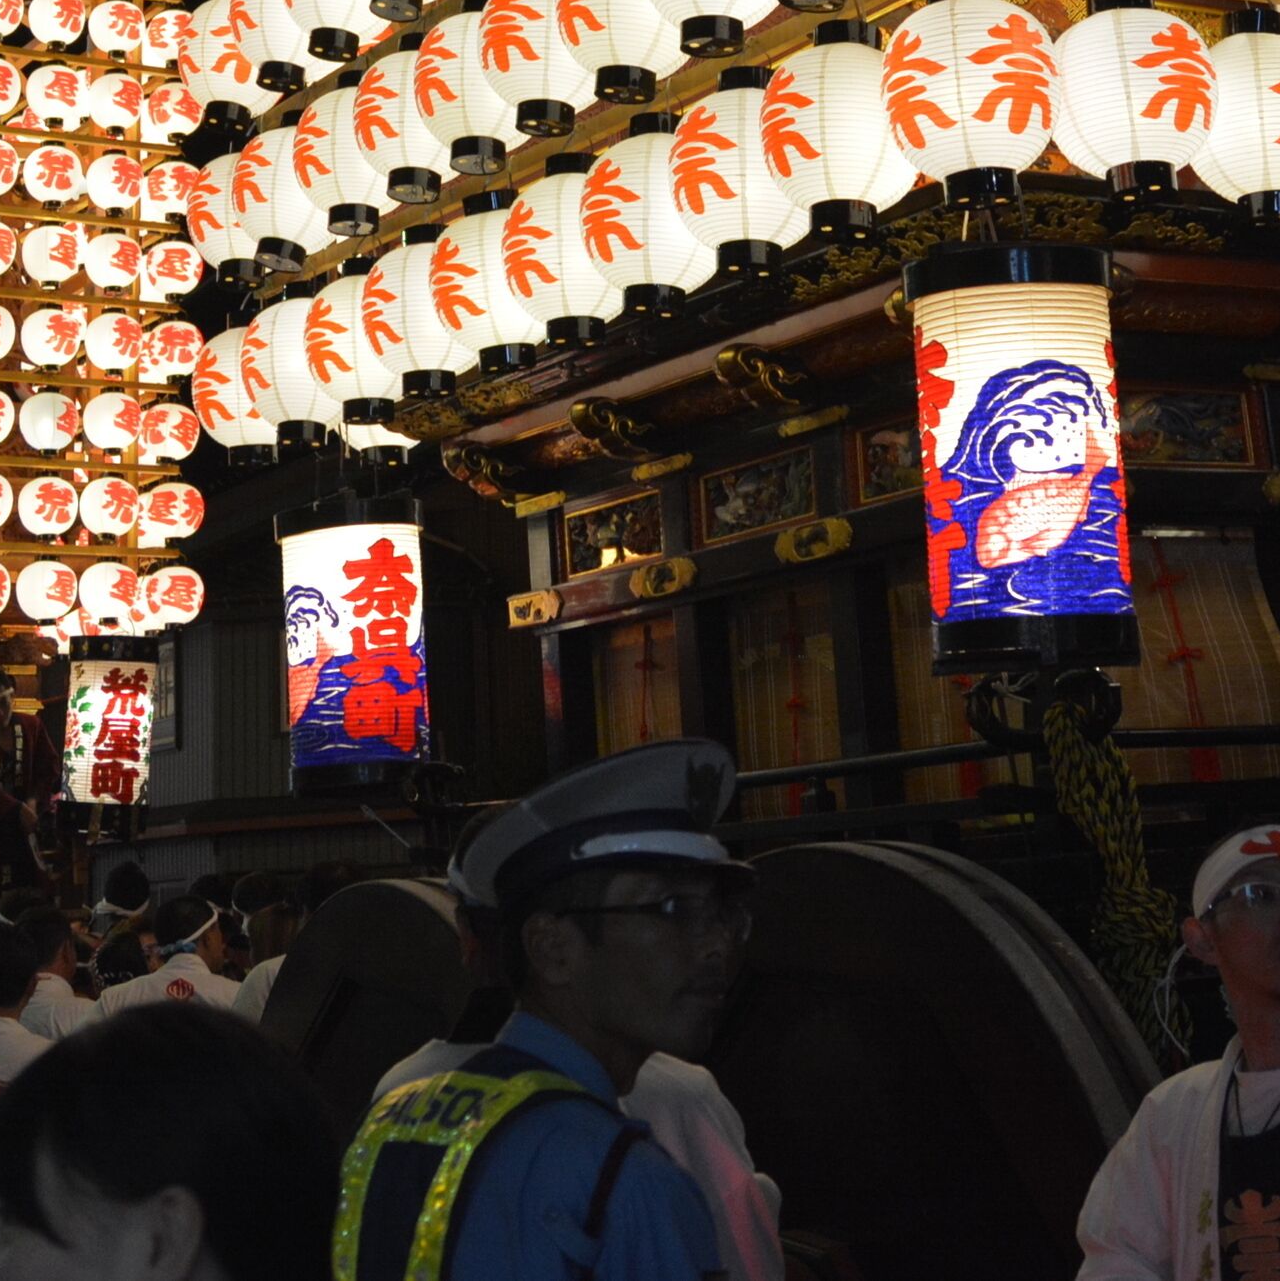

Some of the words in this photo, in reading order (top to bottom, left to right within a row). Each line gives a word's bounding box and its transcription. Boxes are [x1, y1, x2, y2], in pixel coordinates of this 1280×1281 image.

[343, 538, 422, 752] 奈呉町
[91, 667, 146, 804] 荒屋町
